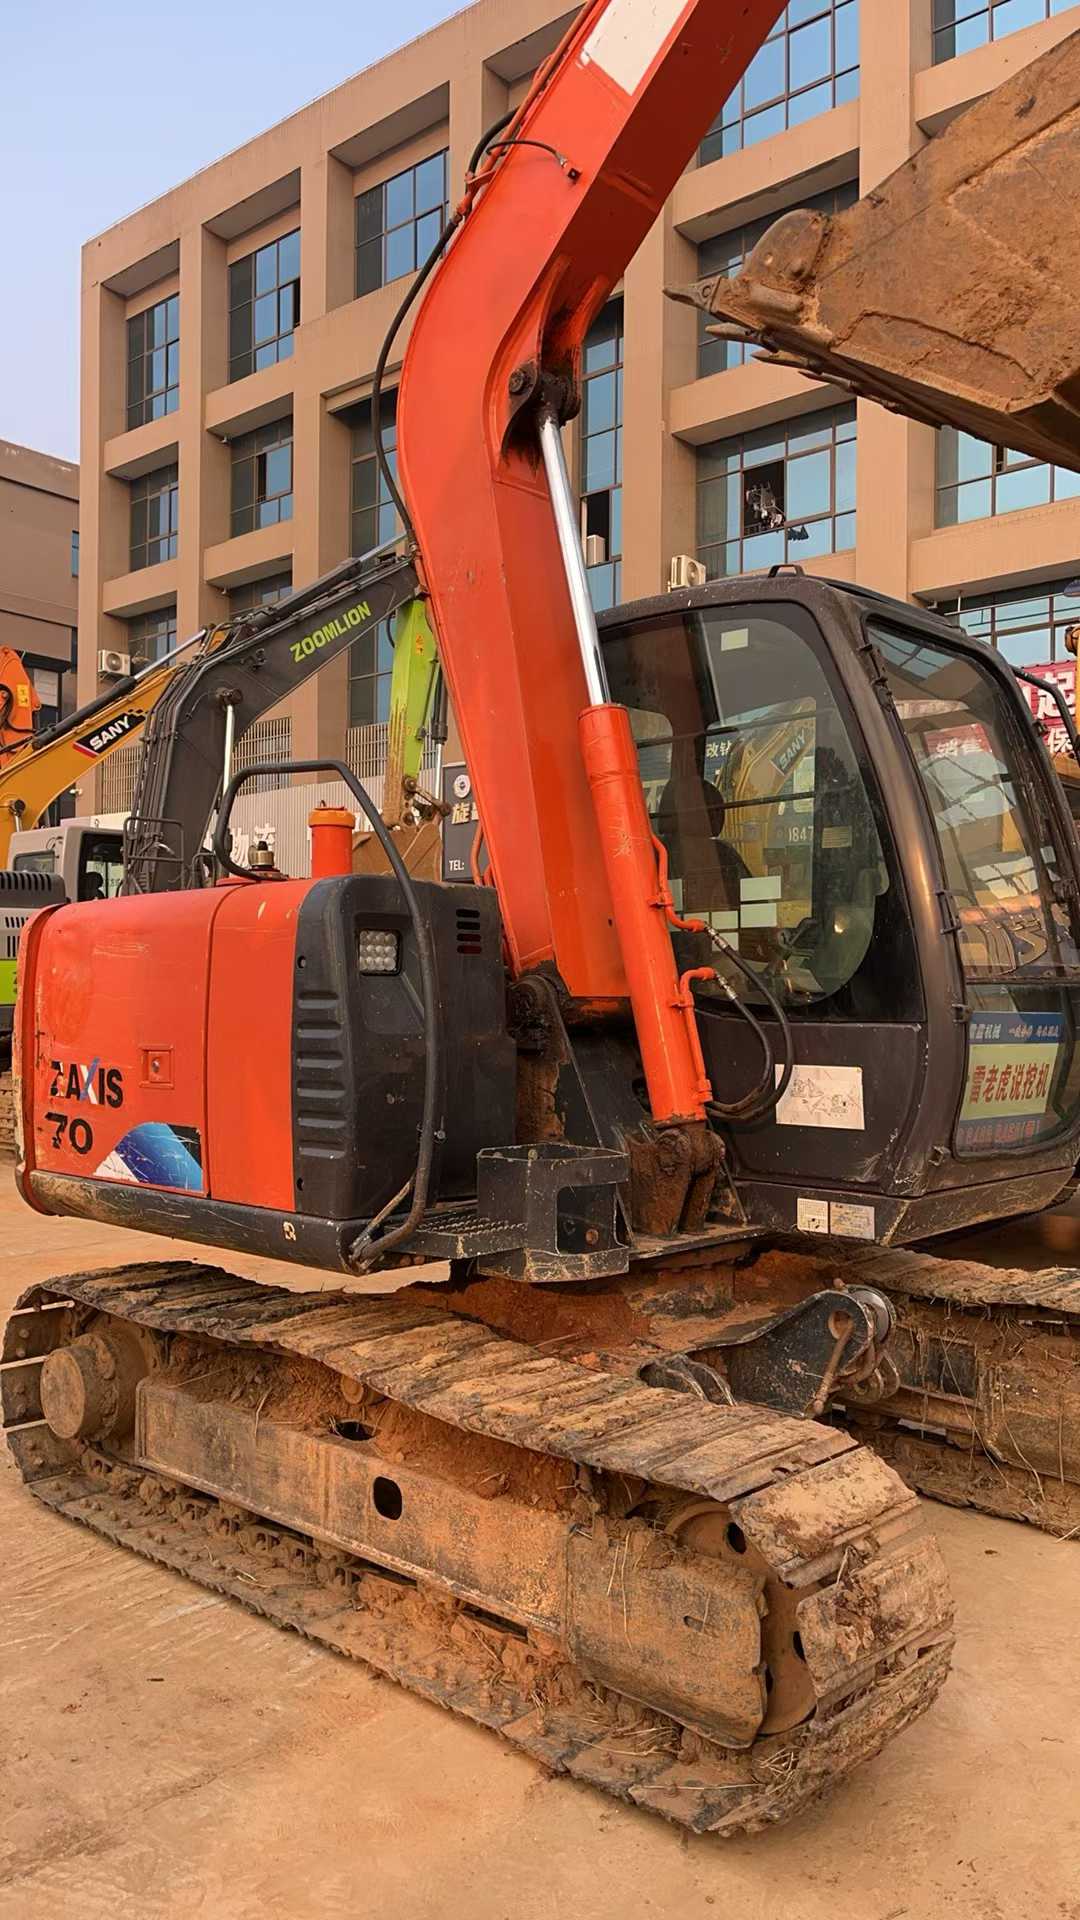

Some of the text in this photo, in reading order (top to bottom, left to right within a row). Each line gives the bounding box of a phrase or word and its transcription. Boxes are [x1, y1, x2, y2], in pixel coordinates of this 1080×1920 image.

[290, 601, 372, 663] ZOOMLION
[89, 715, 132, 750] SANY
[778, 728, 808, 769] SANY
[448, 859, 465, 872] TEL:
[45, 1111, 94, 1155] 70
